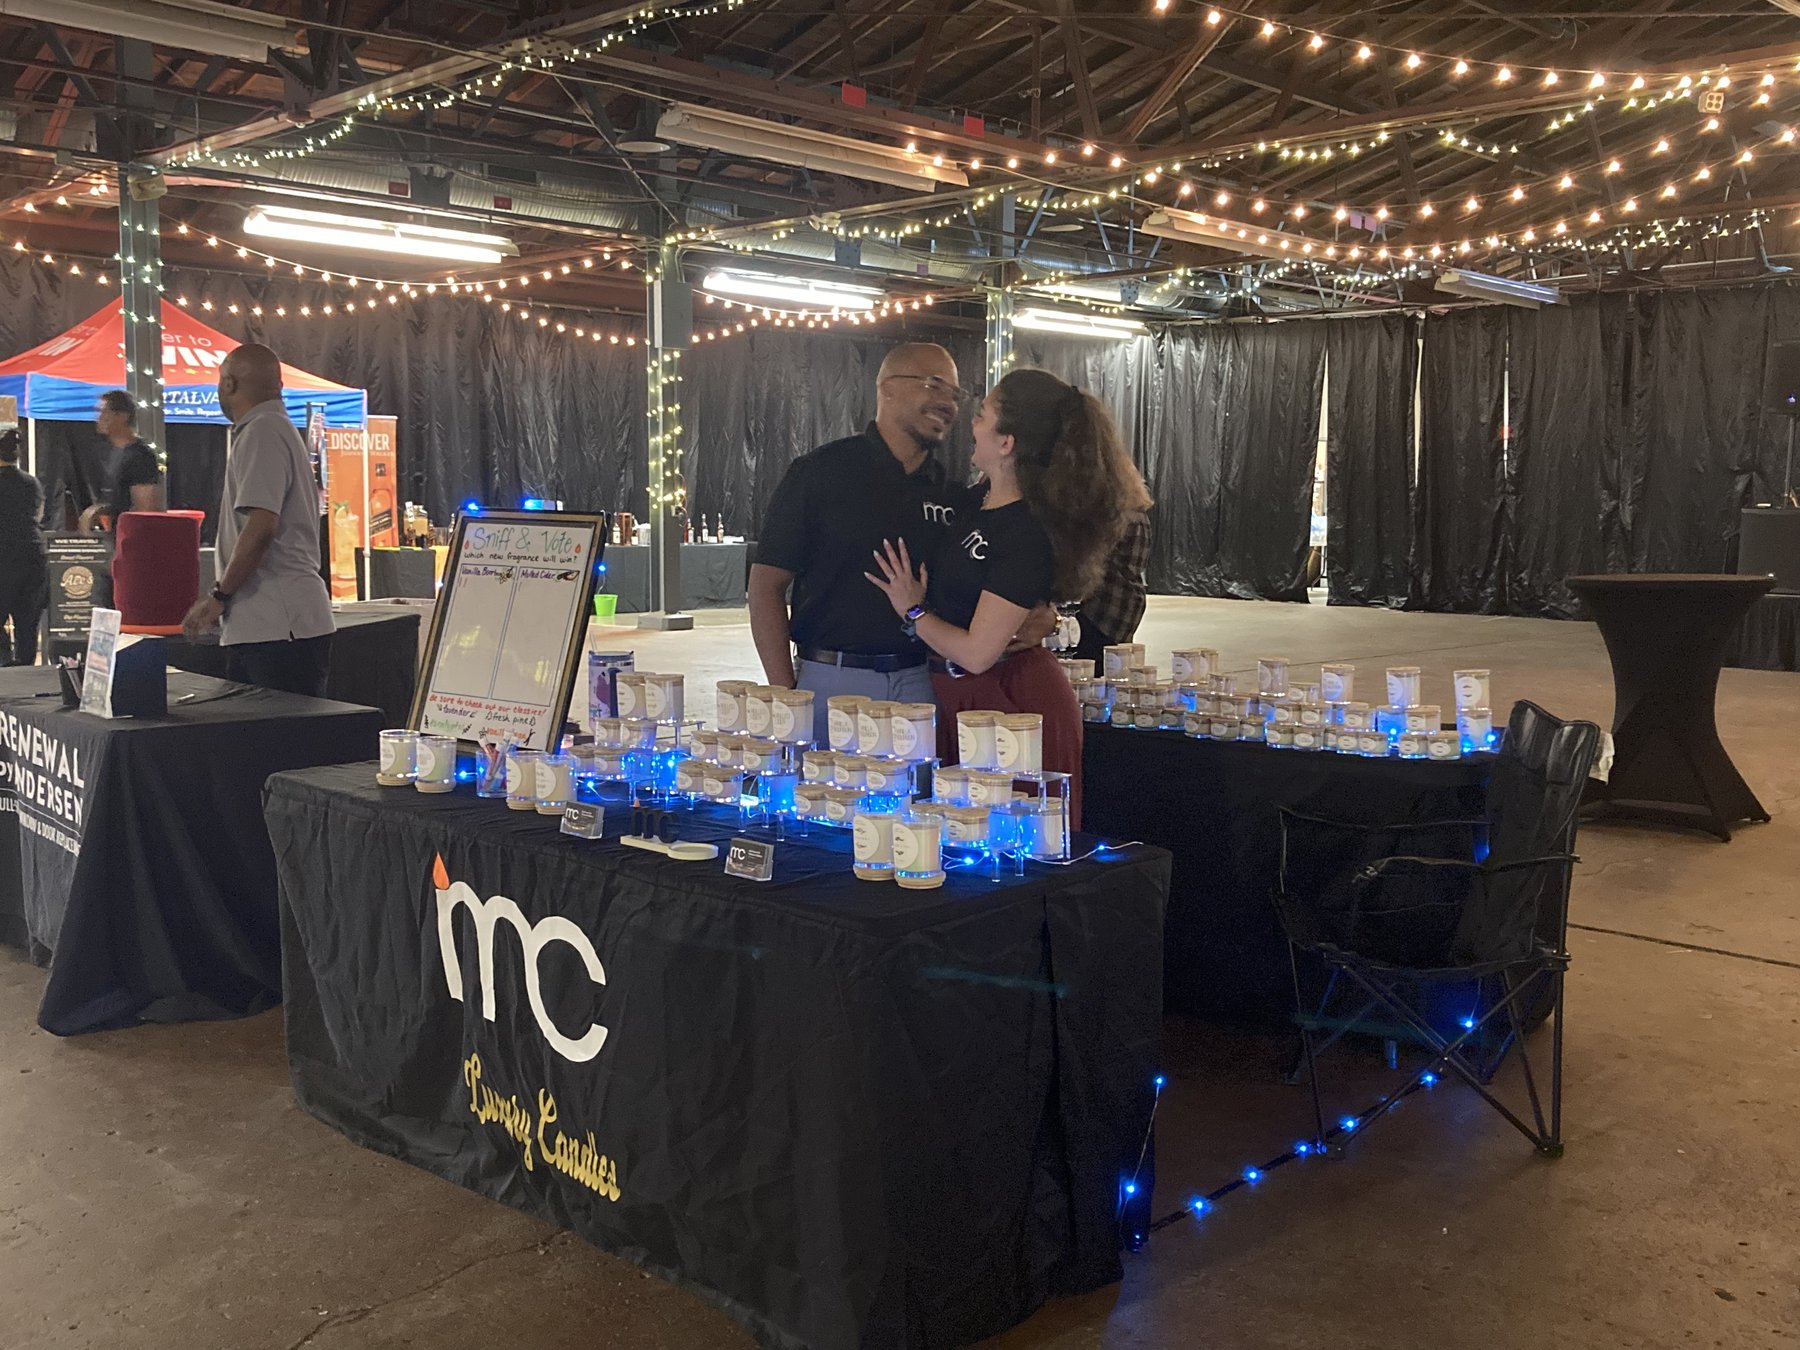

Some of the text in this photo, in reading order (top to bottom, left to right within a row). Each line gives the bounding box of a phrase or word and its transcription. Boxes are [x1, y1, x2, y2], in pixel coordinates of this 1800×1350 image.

[188, 334, 212, 347] to
[162, 345, 228, 368] IN
[473, 527, 573, 554] Sniff & Vote
[464, 551, 484, 559] which
[489, 552, 504, 560] new
[507, 552, 539, 564] fragrance
[559, 556, 578, 564] win?
[0, 711, 85, 789] RENEWAL
[15, 760, 84, 828] NDERSEN
[537, 1088, 622, 1202] Candles
